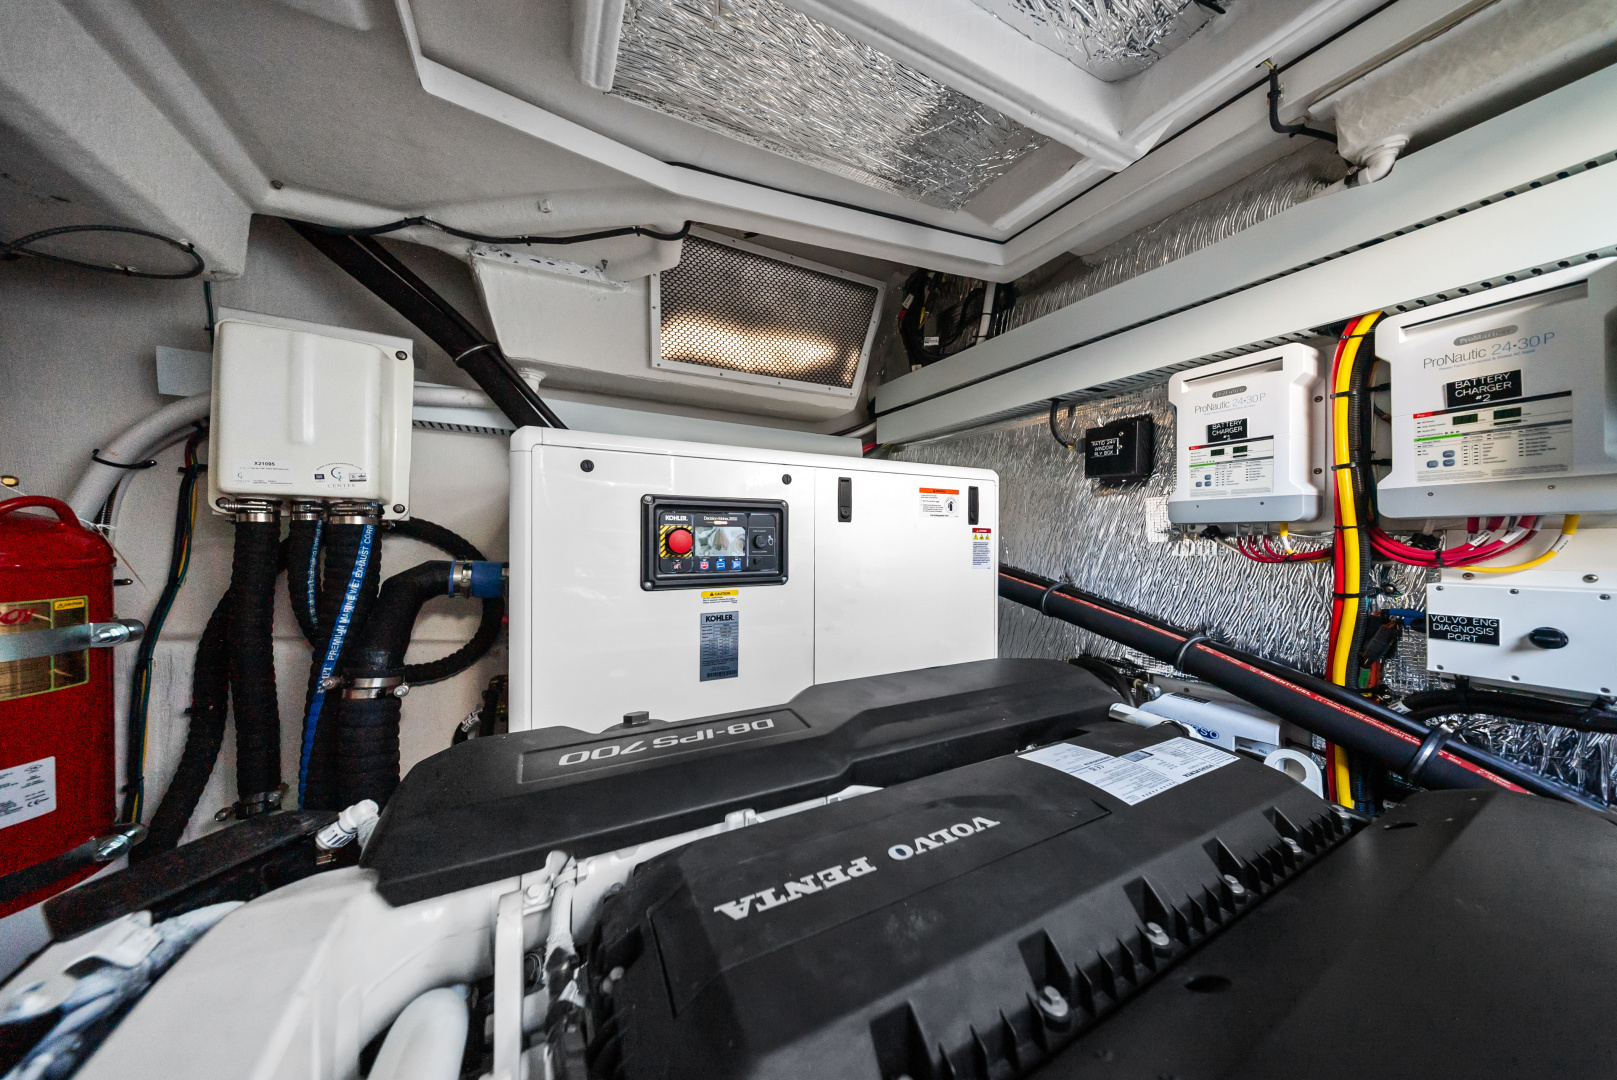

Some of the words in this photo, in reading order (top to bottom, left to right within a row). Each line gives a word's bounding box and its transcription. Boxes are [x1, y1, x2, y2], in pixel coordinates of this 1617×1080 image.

[1423, 348, 1487, 369] ProNautic
[1455, 372, 1511, 389] BATTERY
[1455, 381, 1512, 398] CHARGER
[1475, 394, 1491, 402] #2
[1194, 400, 1230, 414] ProNautic
[1211, 426, 1243, 436] CHARGER
[1212, 419, 1243, 430] BATTERY
[327, 624, 348, 661] PREMIUM
[339, 594, 356, 624] MARINE
[349, 578, 360, 596] WET
[355, 546, 370, 578] EXHAUST
[1430, 614, 1468, 624] VOLVO
[1472, 618, 1498, 627] ENG
[1432, 623, 1495, 636] DIAGNOSIS
[1447, 632, 1478, 642] PORT
[652, 718, 775, 749] D8-IPS
[558, 740, 648, 766] 700
[888, 816, 1001, 861] VOLVO
[713, 856, 877, 921] PENTA
